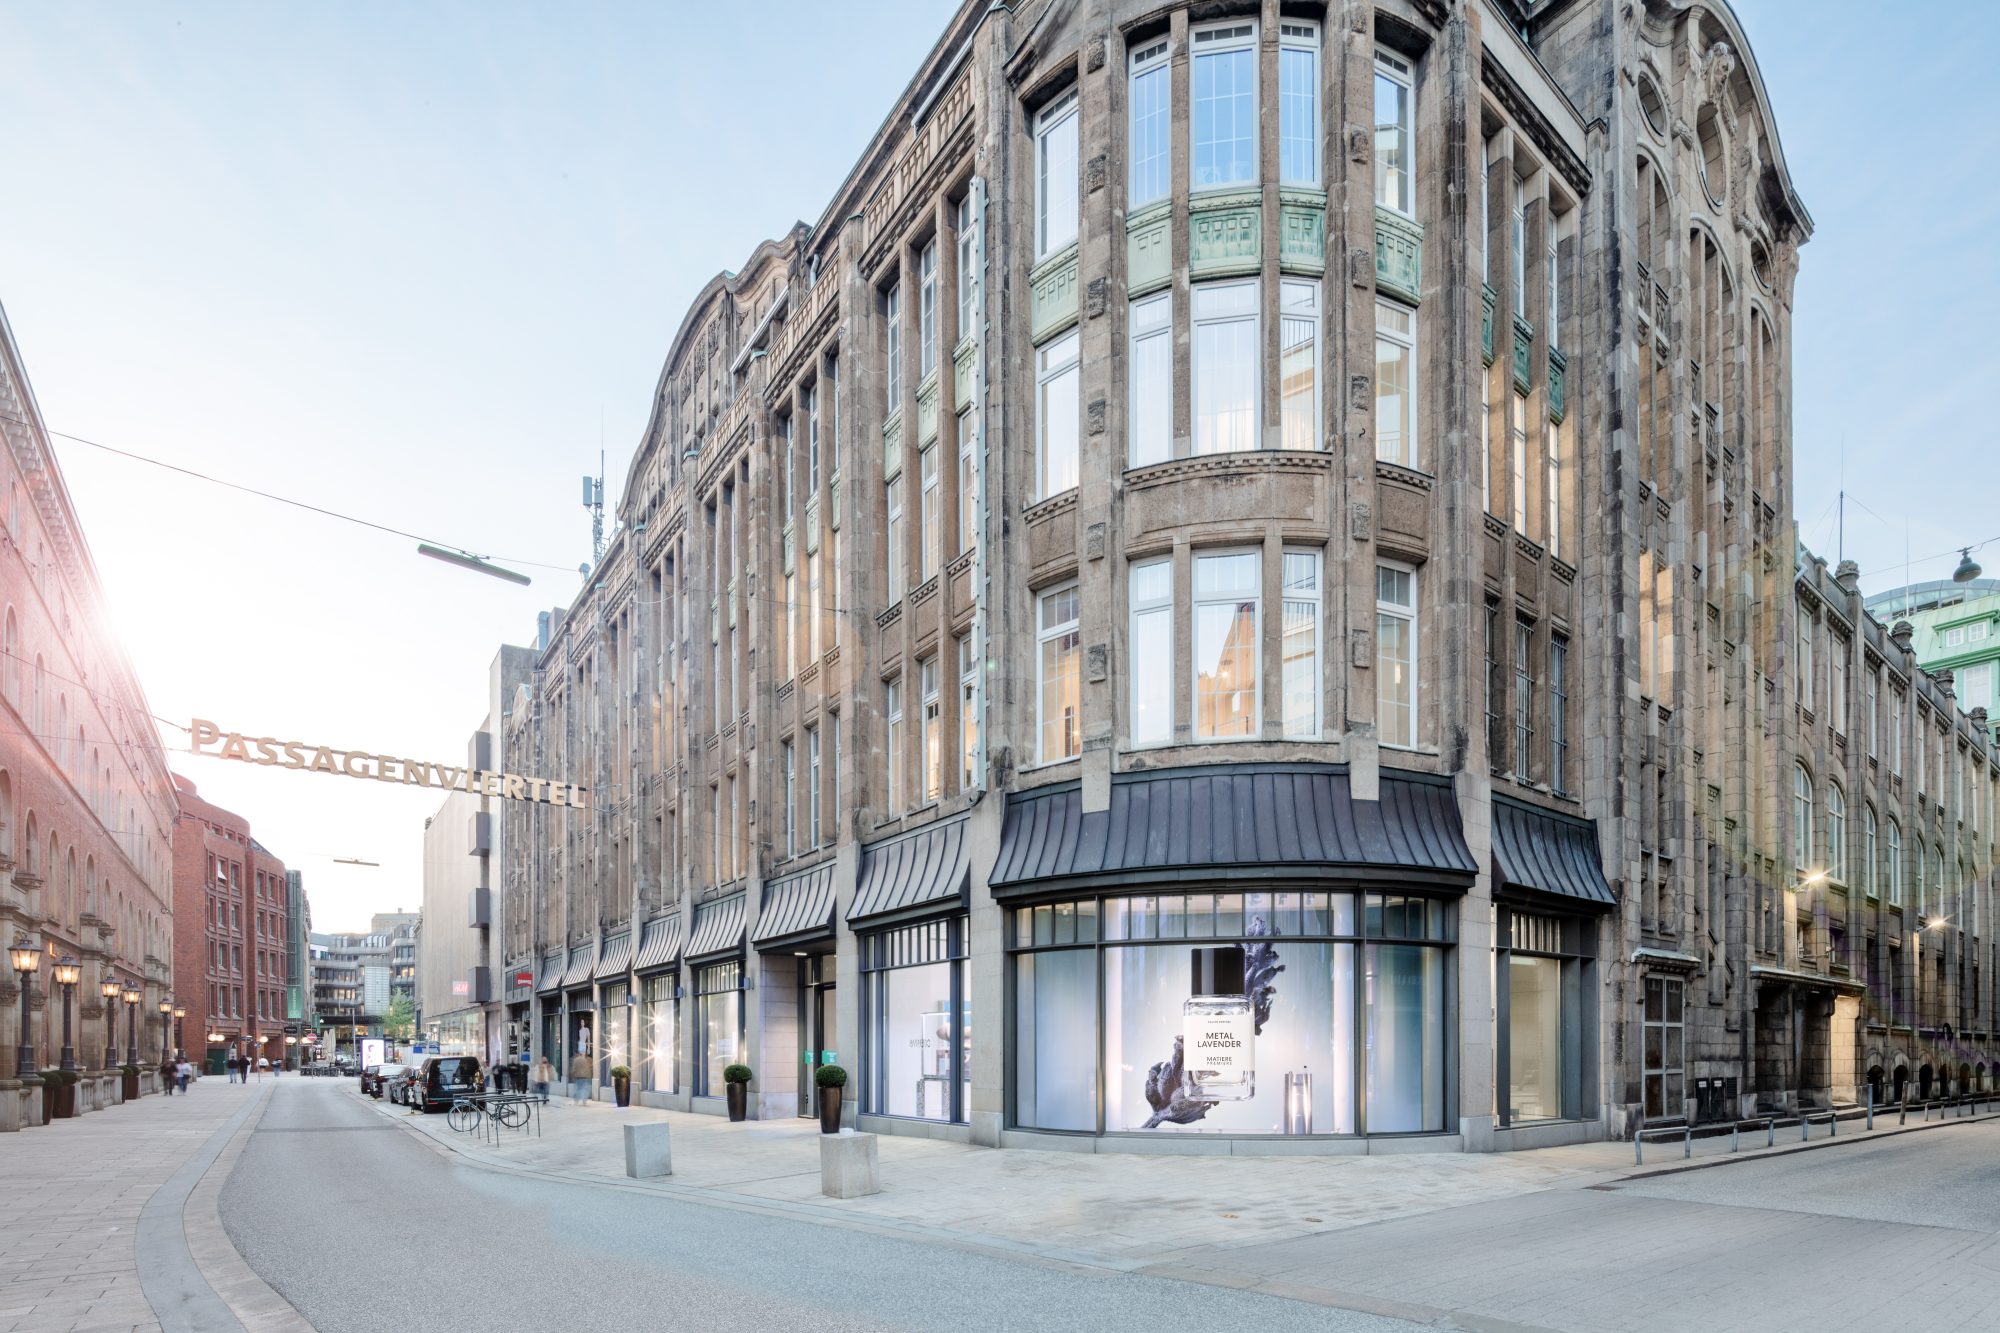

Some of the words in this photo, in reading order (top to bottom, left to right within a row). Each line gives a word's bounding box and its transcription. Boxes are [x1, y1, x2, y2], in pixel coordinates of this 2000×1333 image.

[190, 719, 586, 809] PASSAGENVIERTEL
[1206, 1032, 1235, 1040] METAL
[1198, 1040, 1242, 1048] LAVENDER
